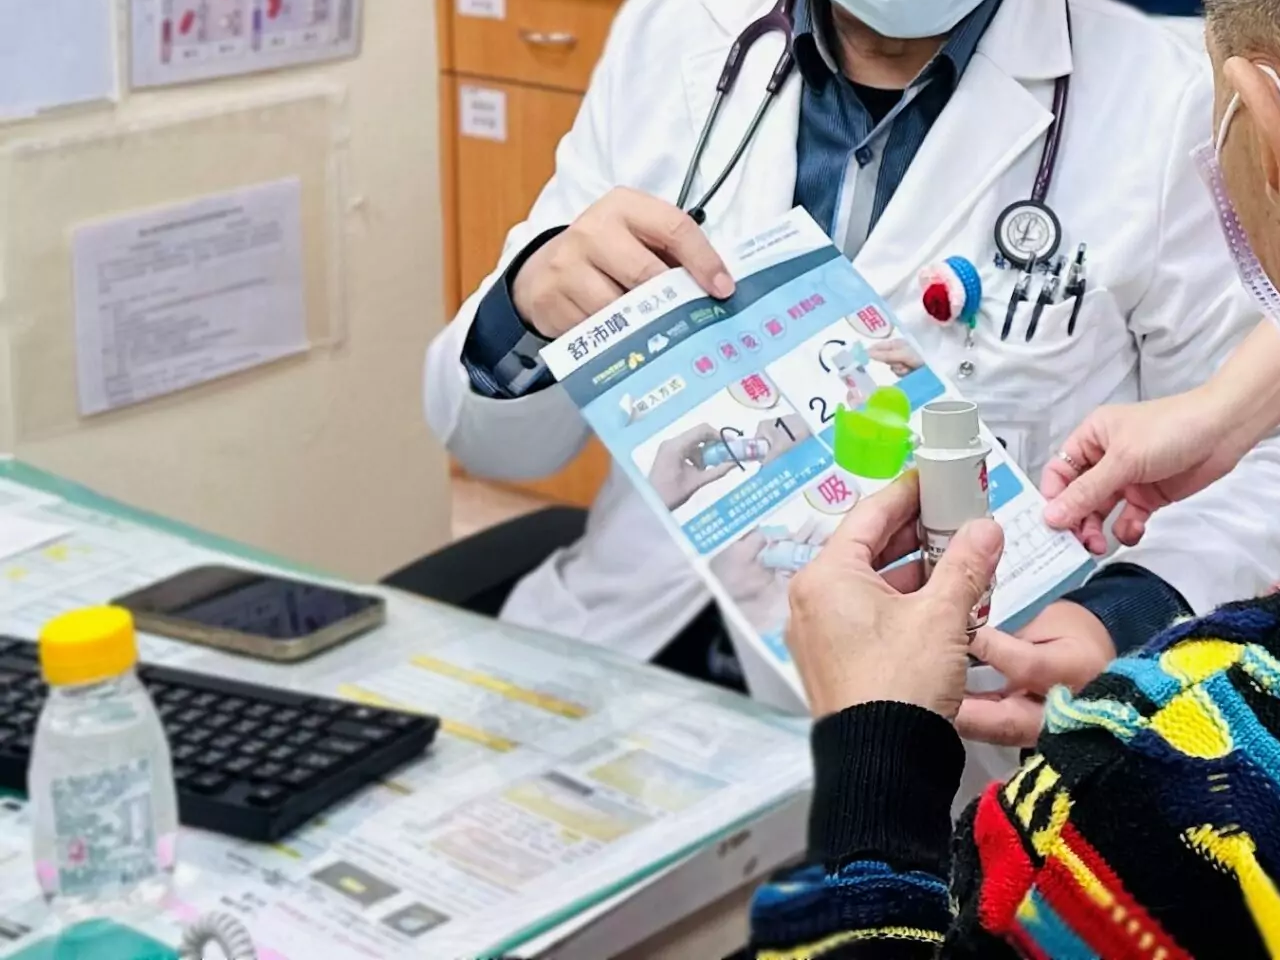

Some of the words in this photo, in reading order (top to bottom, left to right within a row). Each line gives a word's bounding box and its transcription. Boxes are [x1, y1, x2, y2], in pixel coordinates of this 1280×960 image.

[856, 304, 888, 333] 開
[808, 396, 836, 424] 2
[774, 416, 797, 442] 1
[817, 473, 853, 506] 吸
